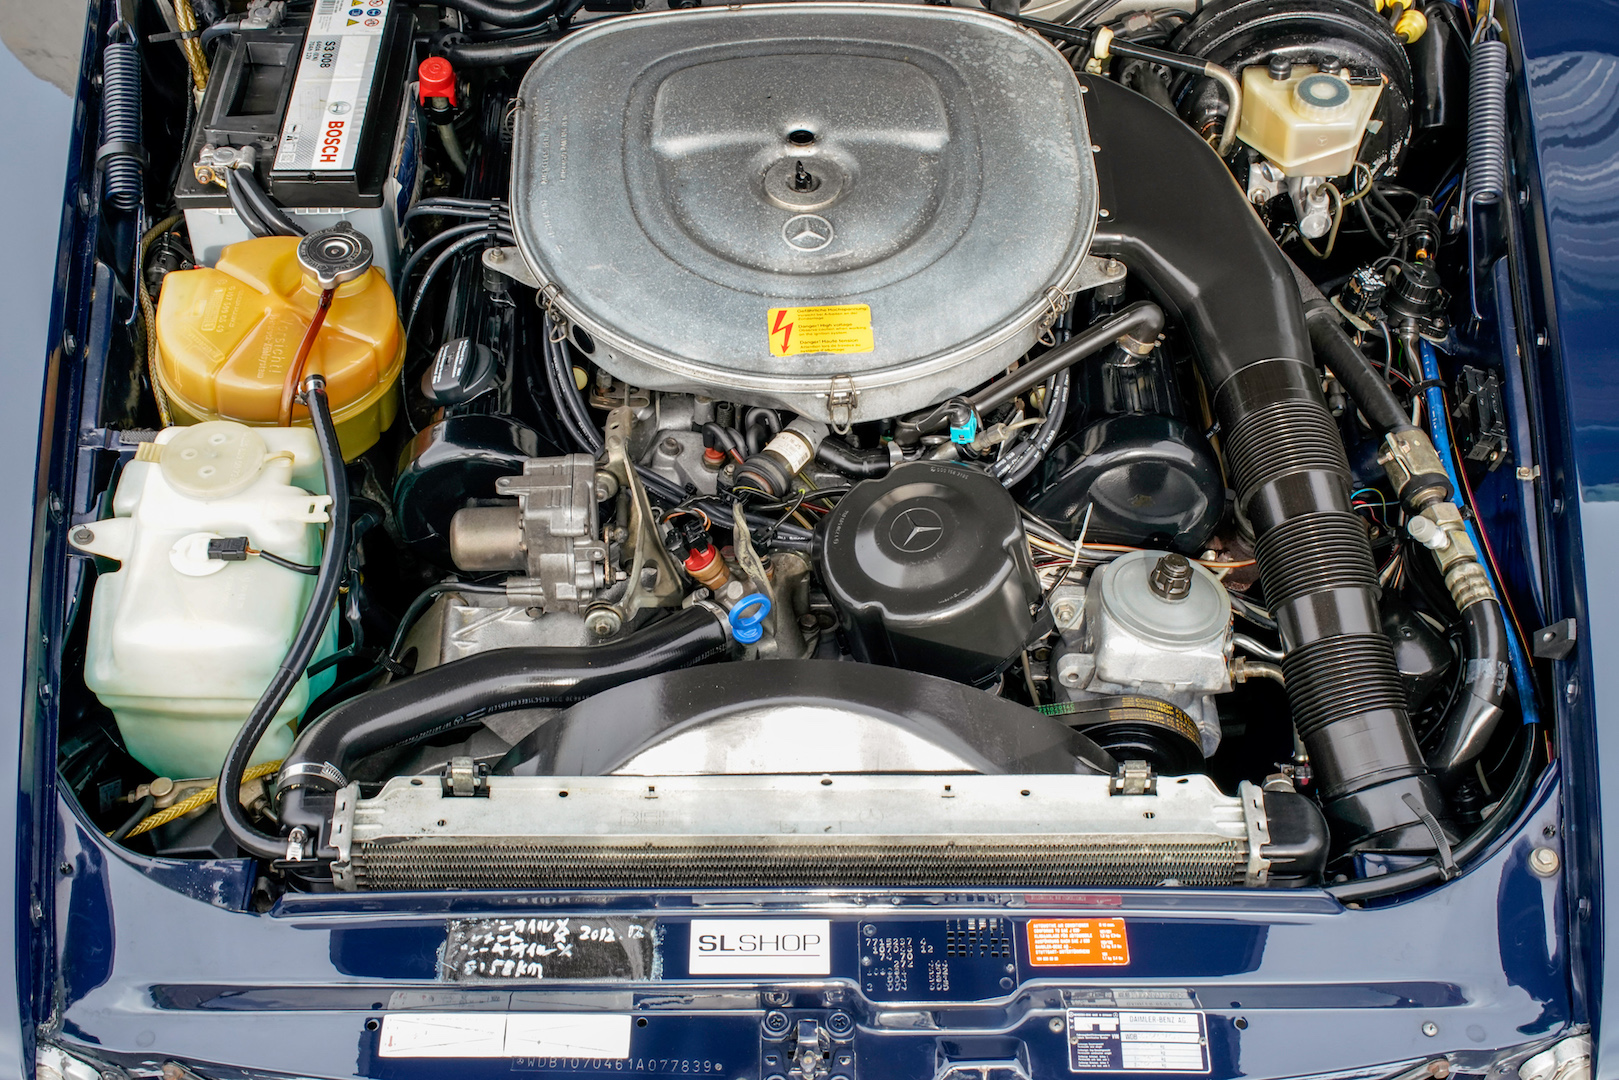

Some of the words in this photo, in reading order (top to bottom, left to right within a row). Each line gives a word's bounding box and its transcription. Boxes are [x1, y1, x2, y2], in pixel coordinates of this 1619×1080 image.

[324, 40, 336, 52] S3
[320, 53, 333, 68] 008
[320, 121, 344, 163] BOSCH
